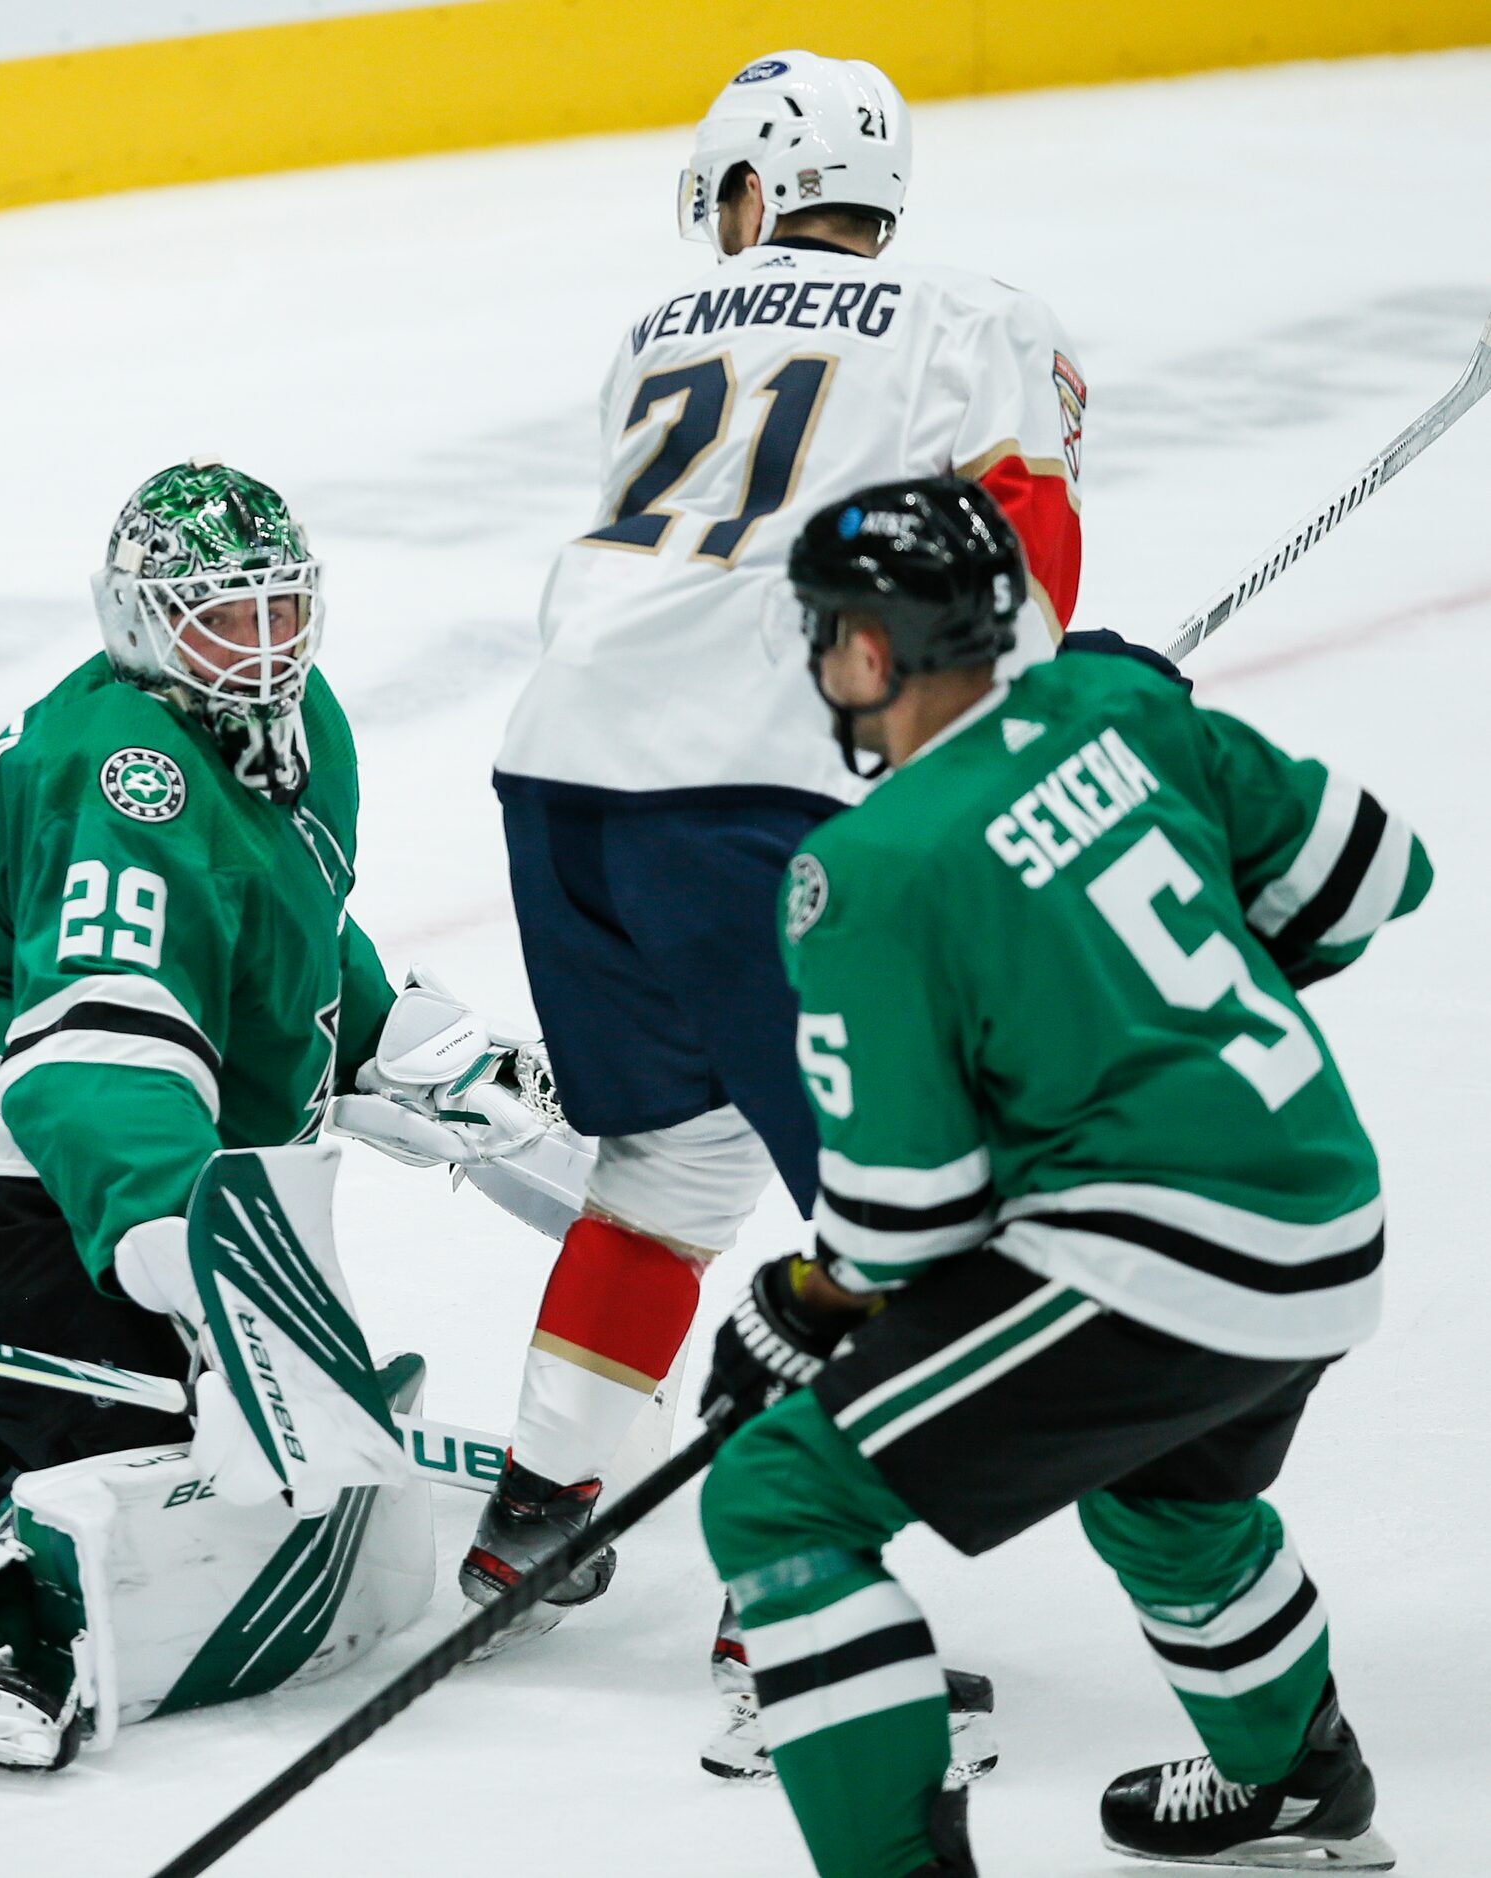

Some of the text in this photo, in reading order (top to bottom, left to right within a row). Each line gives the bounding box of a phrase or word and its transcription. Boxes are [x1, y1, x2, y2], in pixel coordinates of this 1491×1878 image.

[858, 105, 887, 140] 21
[631, 281, 901, 355] WENNBERG
[574, 350, 840, 571] 21
[992, 572, 1012, 615] 5
[984, 726, 1160, 890] SEKERA
[57, 859, 168, 970] 29
[1086, 827, 1323, 1113] 5
[436, 1030, 474, 1057] OETTINGER
[795, 1013, 853, 1119] 5
[237, 1311, 308, 1463] BAUER
